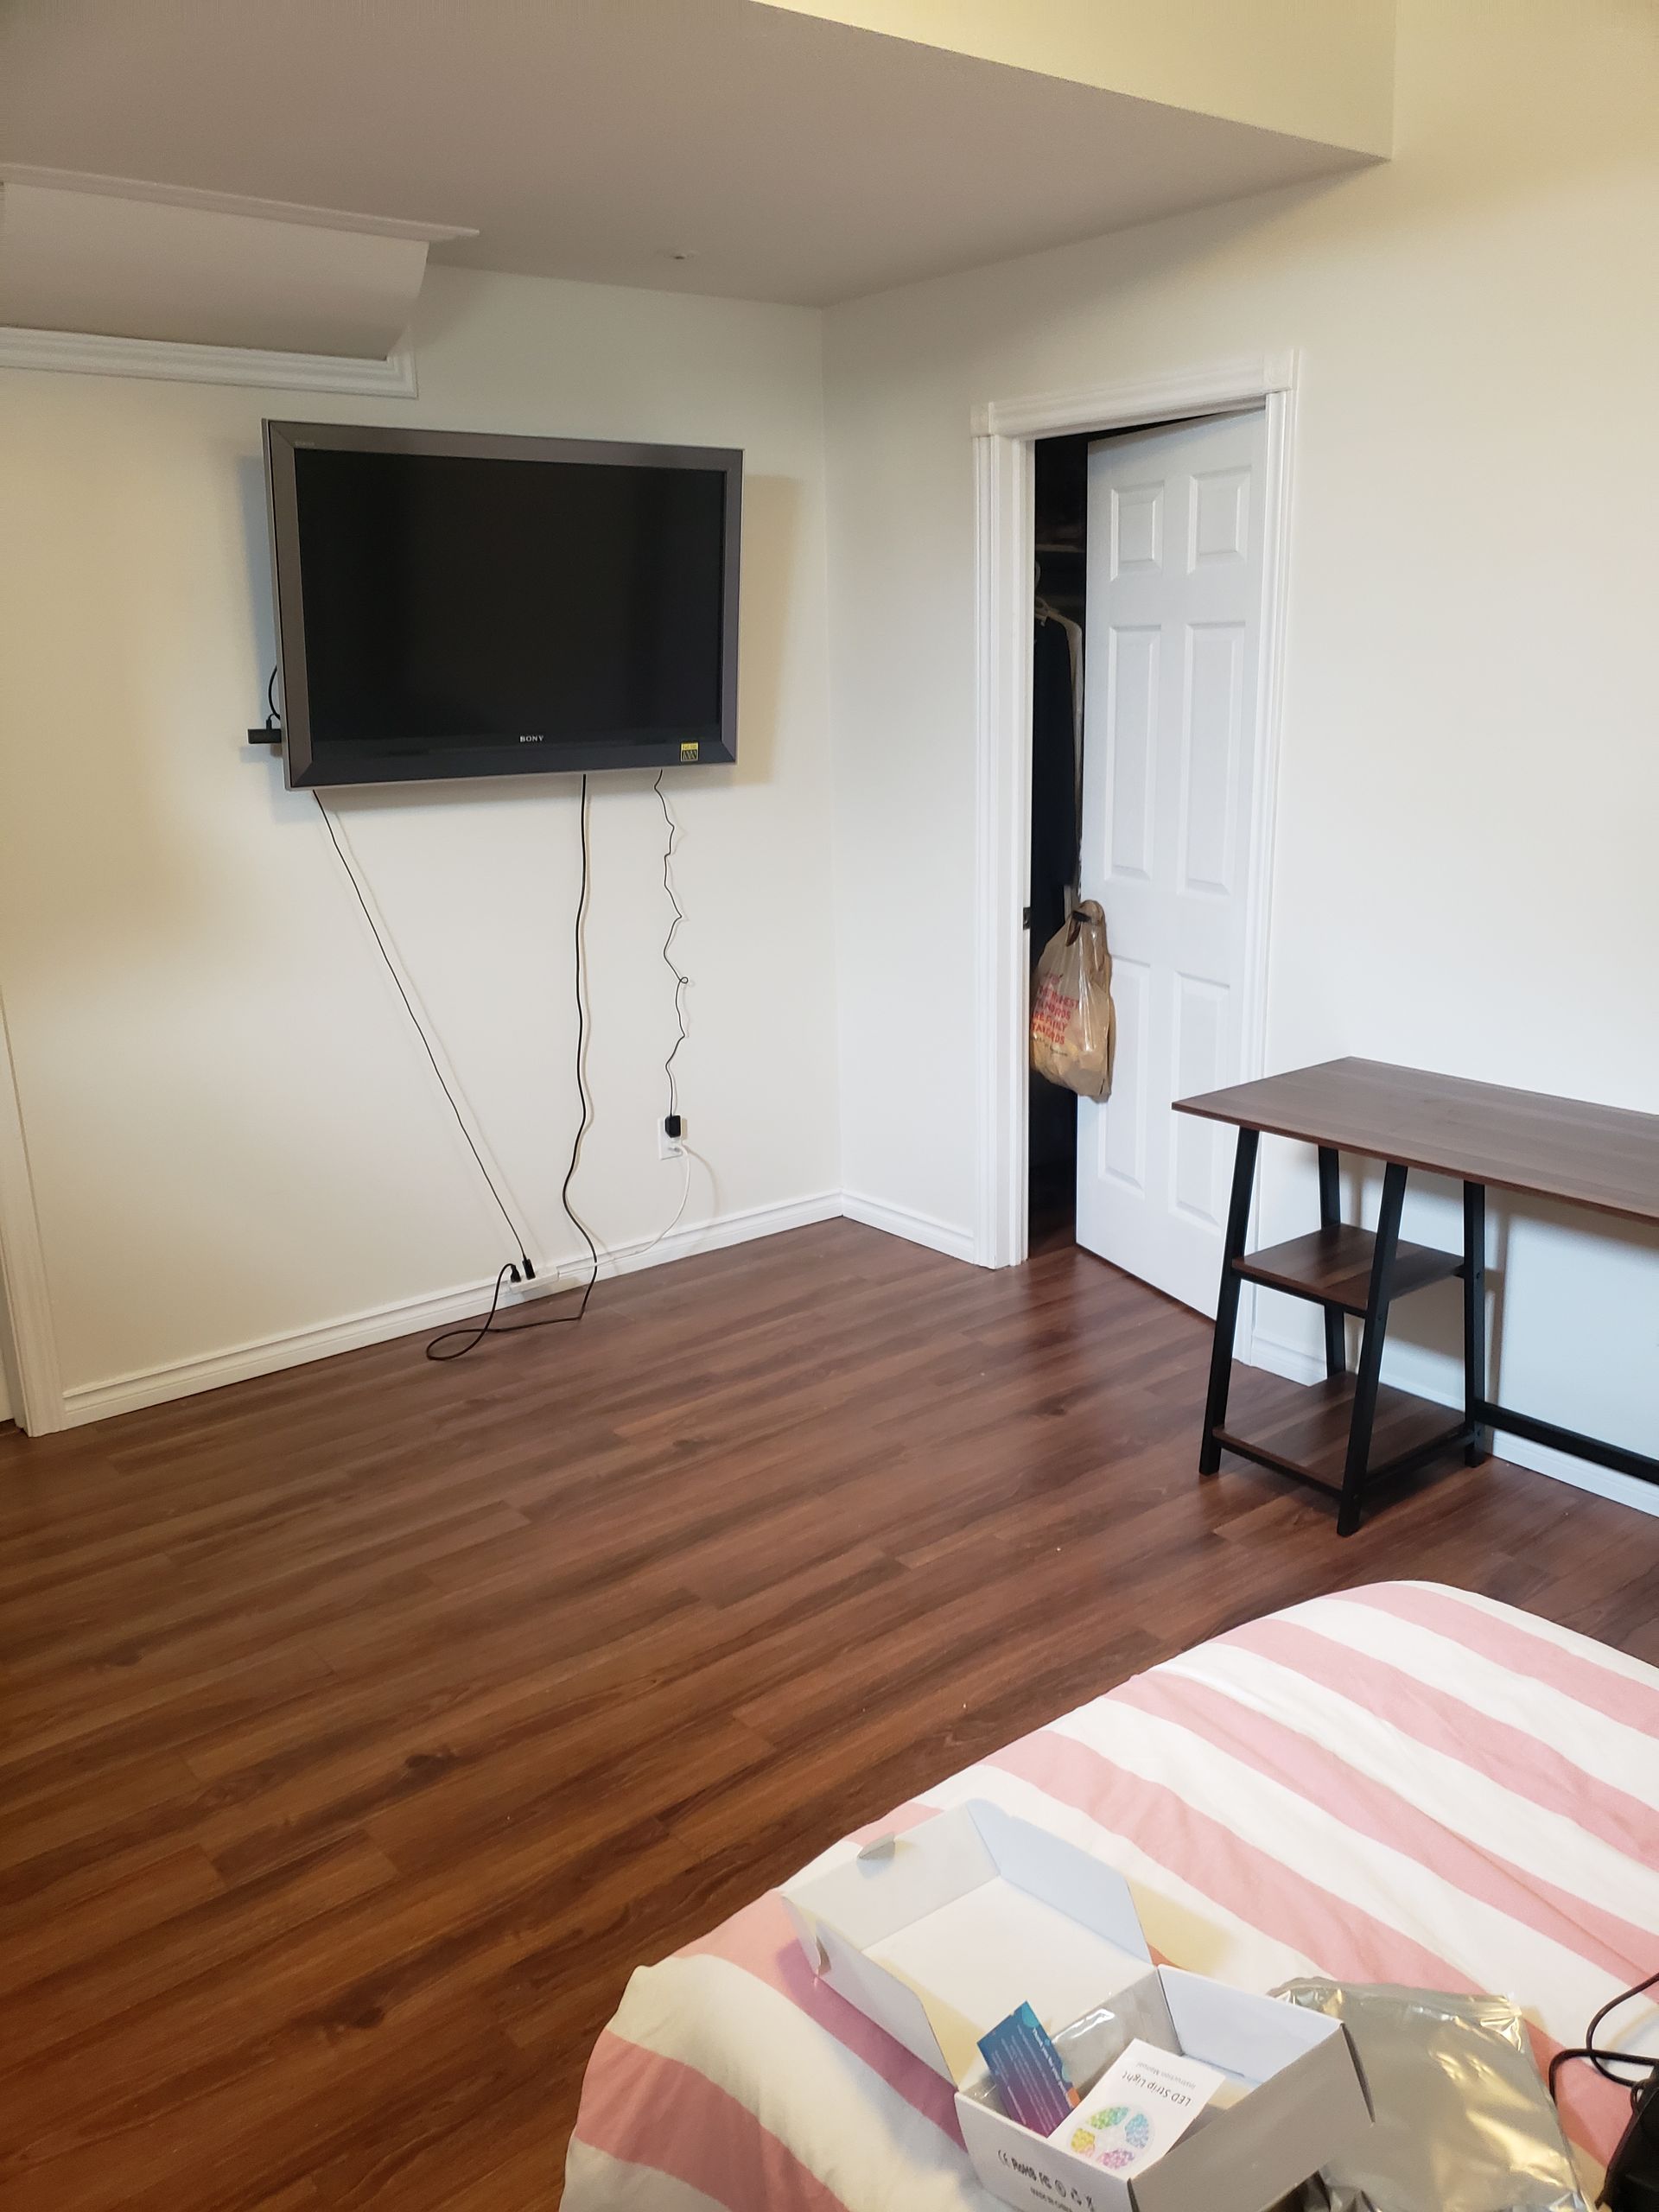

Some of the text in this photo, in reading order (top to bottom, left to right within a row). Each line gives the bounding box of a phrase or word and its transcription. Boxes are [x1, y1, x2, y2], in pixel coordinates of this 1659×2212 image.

[1122, 2070, 1192, 2107] LED Strip Light
